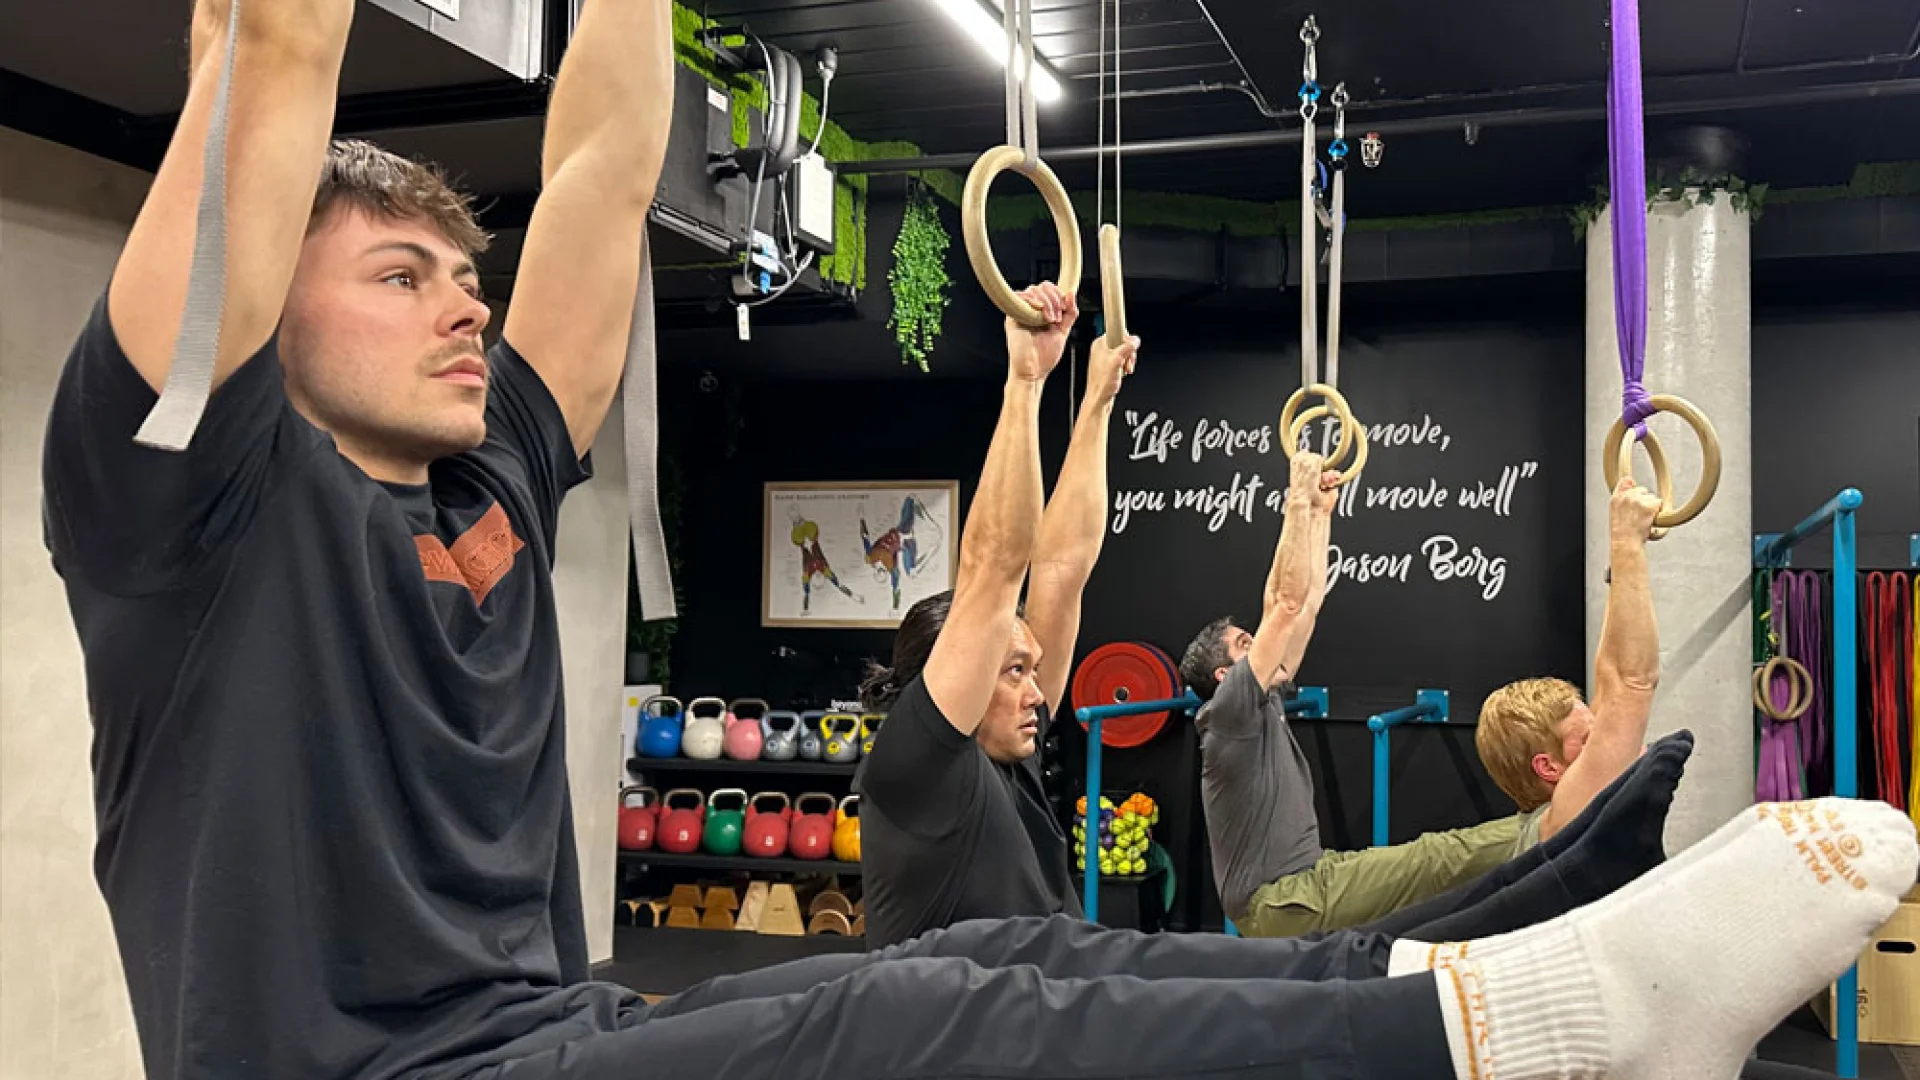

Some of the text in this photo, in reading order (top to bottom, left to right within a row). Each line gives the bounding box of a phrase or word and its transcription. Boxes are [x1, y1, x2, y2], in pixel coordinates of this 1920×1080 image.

[1191, 418, 1271, 463] forces
[1364, 414, 1451, 451] move,
[1112, 490, 1166, 534] you
[1173, 471, 1264, 532] might
[1265, 487, 1291, 515] a
[1366, 478, 1448, 511] move
[1324, 535, 1508, 600] Jason Borg
